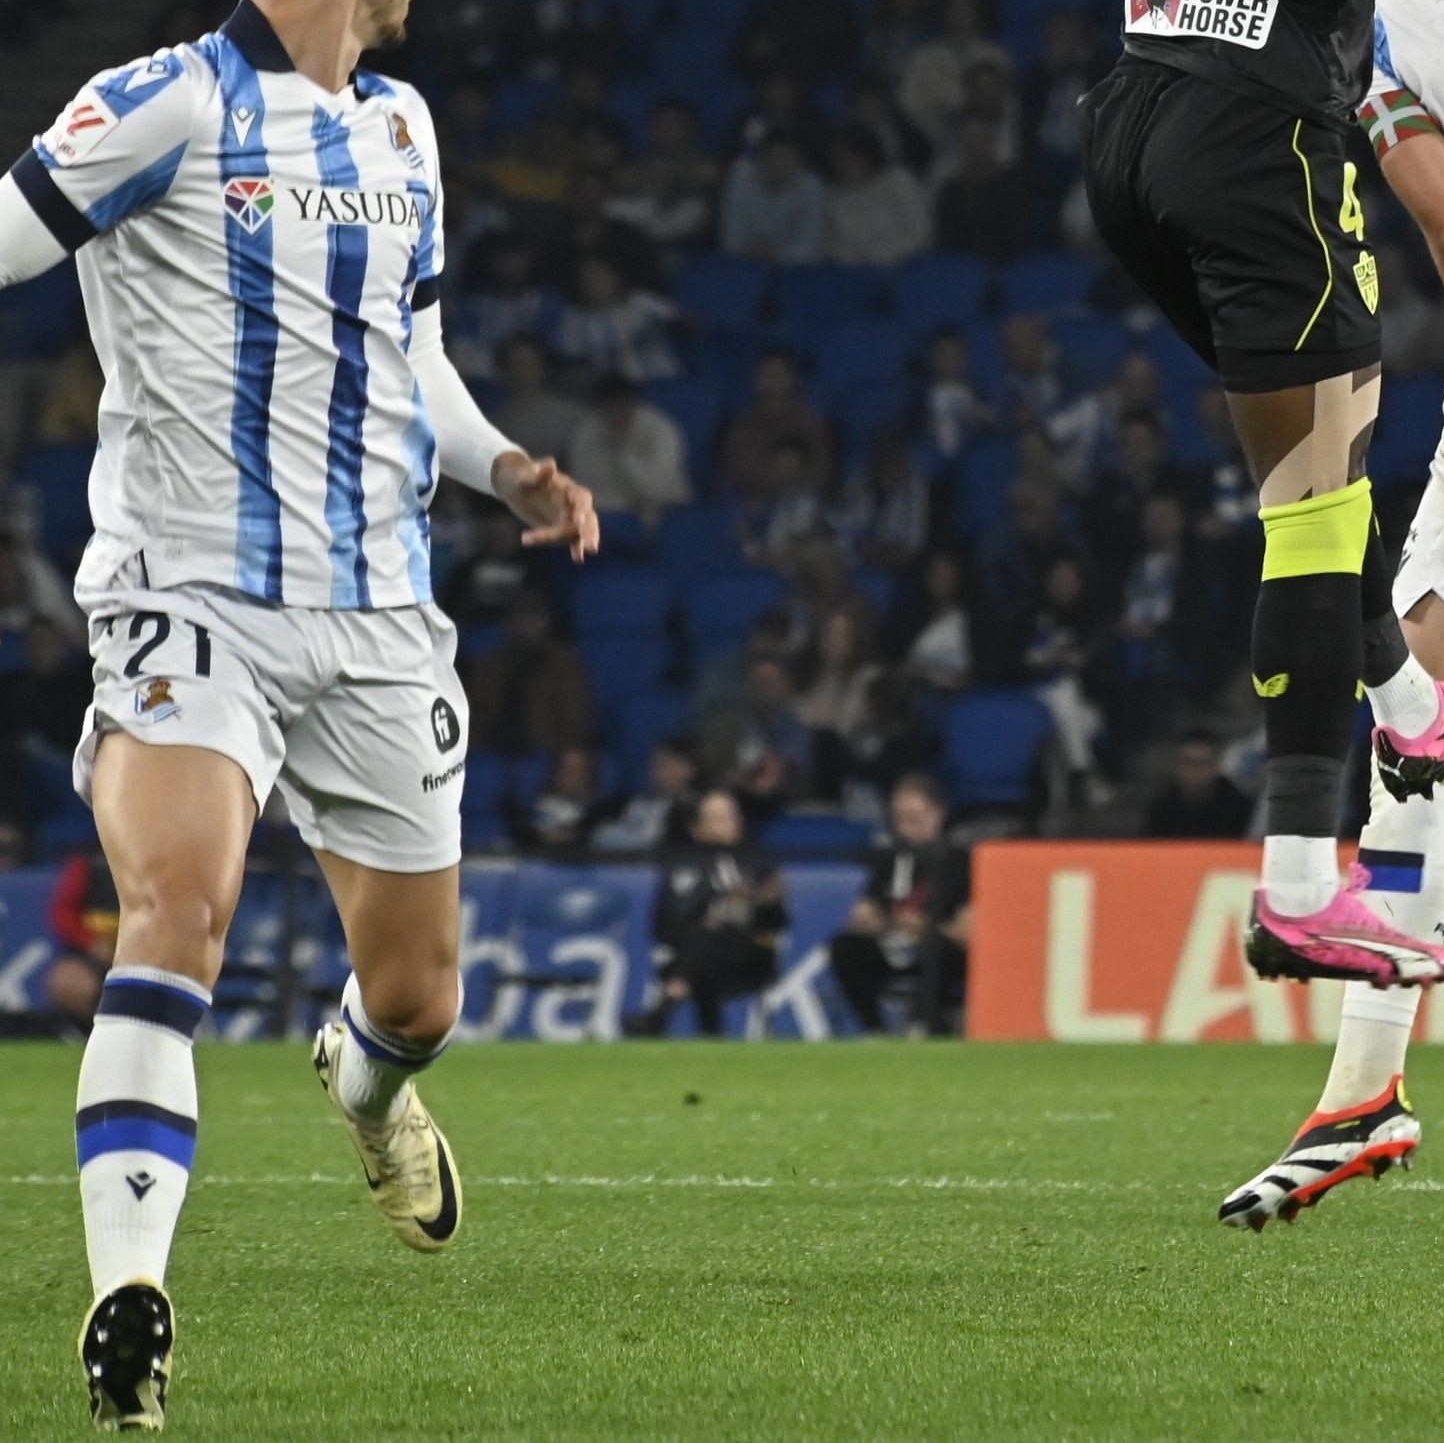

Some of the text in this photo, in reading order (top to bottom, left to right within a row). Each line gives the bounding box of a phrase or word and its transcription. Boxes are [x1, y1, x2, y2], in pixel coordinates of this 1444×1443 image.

[1179, 5, 1264, 41] HORSE
[286, 188, 421, 229] YASUDA
[123, 610, 212, 679] 21
